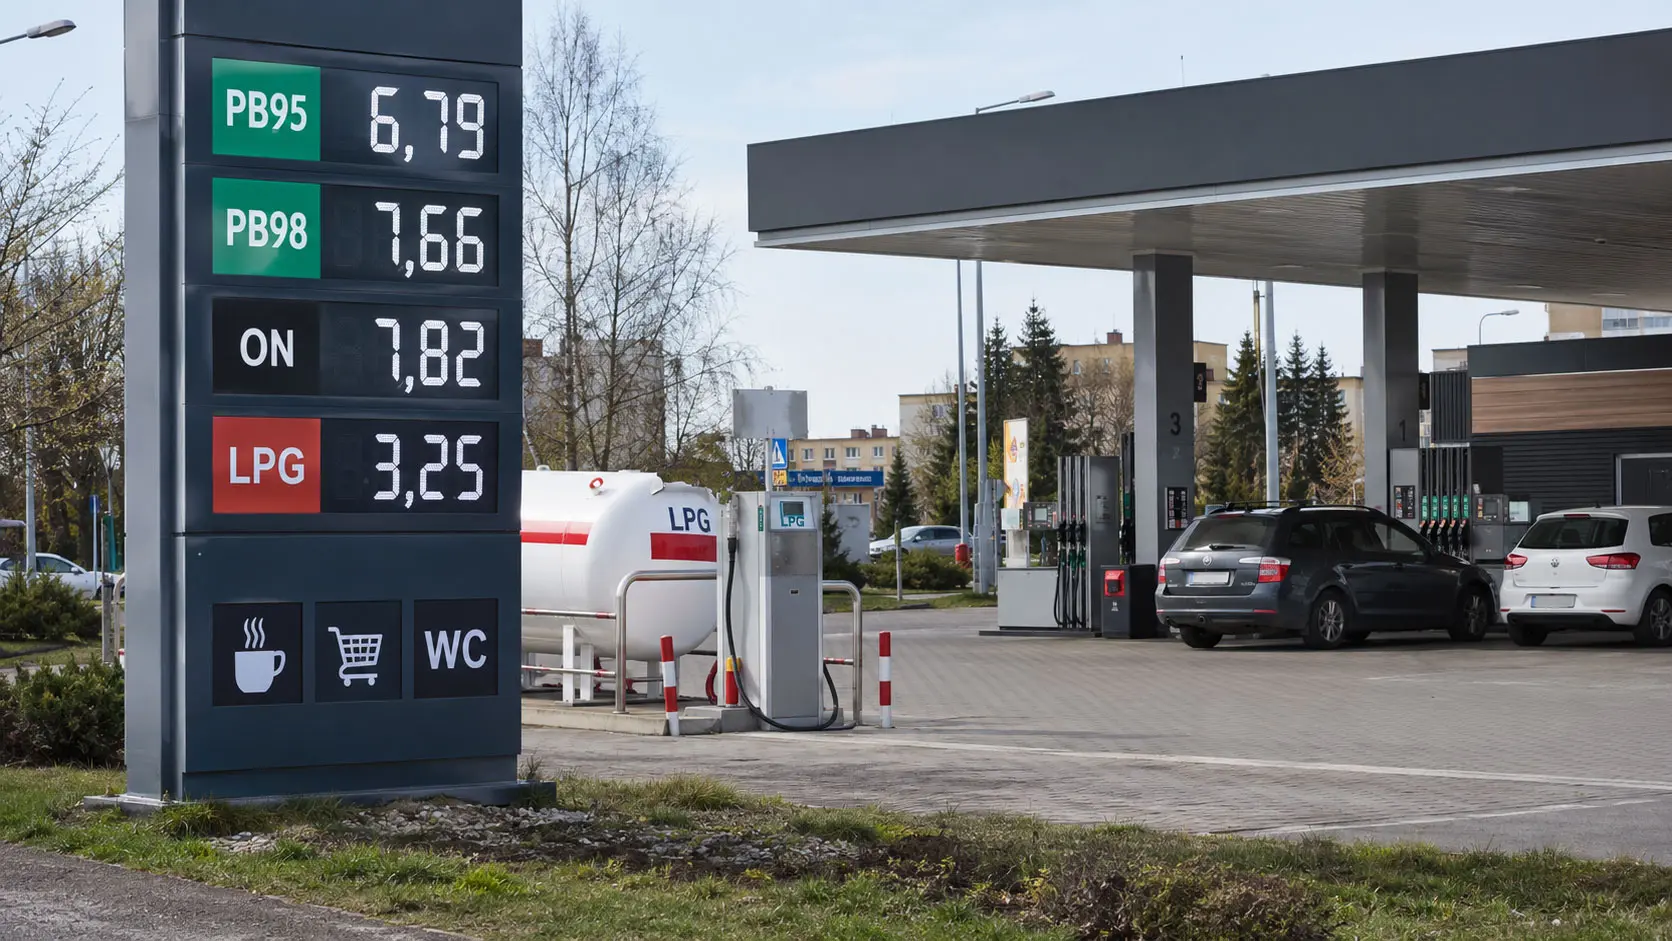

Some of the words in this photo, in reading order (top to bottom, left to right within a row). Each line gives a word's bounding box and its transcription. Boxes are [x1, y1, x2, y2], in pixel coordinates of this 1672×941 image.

[227, 89, 307, 131] PB95
[370, 86, 484, 162] 6,79
[227, 209, 307, 249] PB98
[375, 201, 484, 278] 7,66
[240, 327, 294, 367] ON
[375, 317, 484, 393] 7,82
[1170, 412, 1181, 436] 3
[1398, 419, 1406, 441] 1
[229, 446, 305, 485] LPG
[374, 433, 484, 508] 3,25
[668, 506, 711, 533] LPG
[780, 515, 804, 528] LPG
[425, 629, 487, 670] WC
